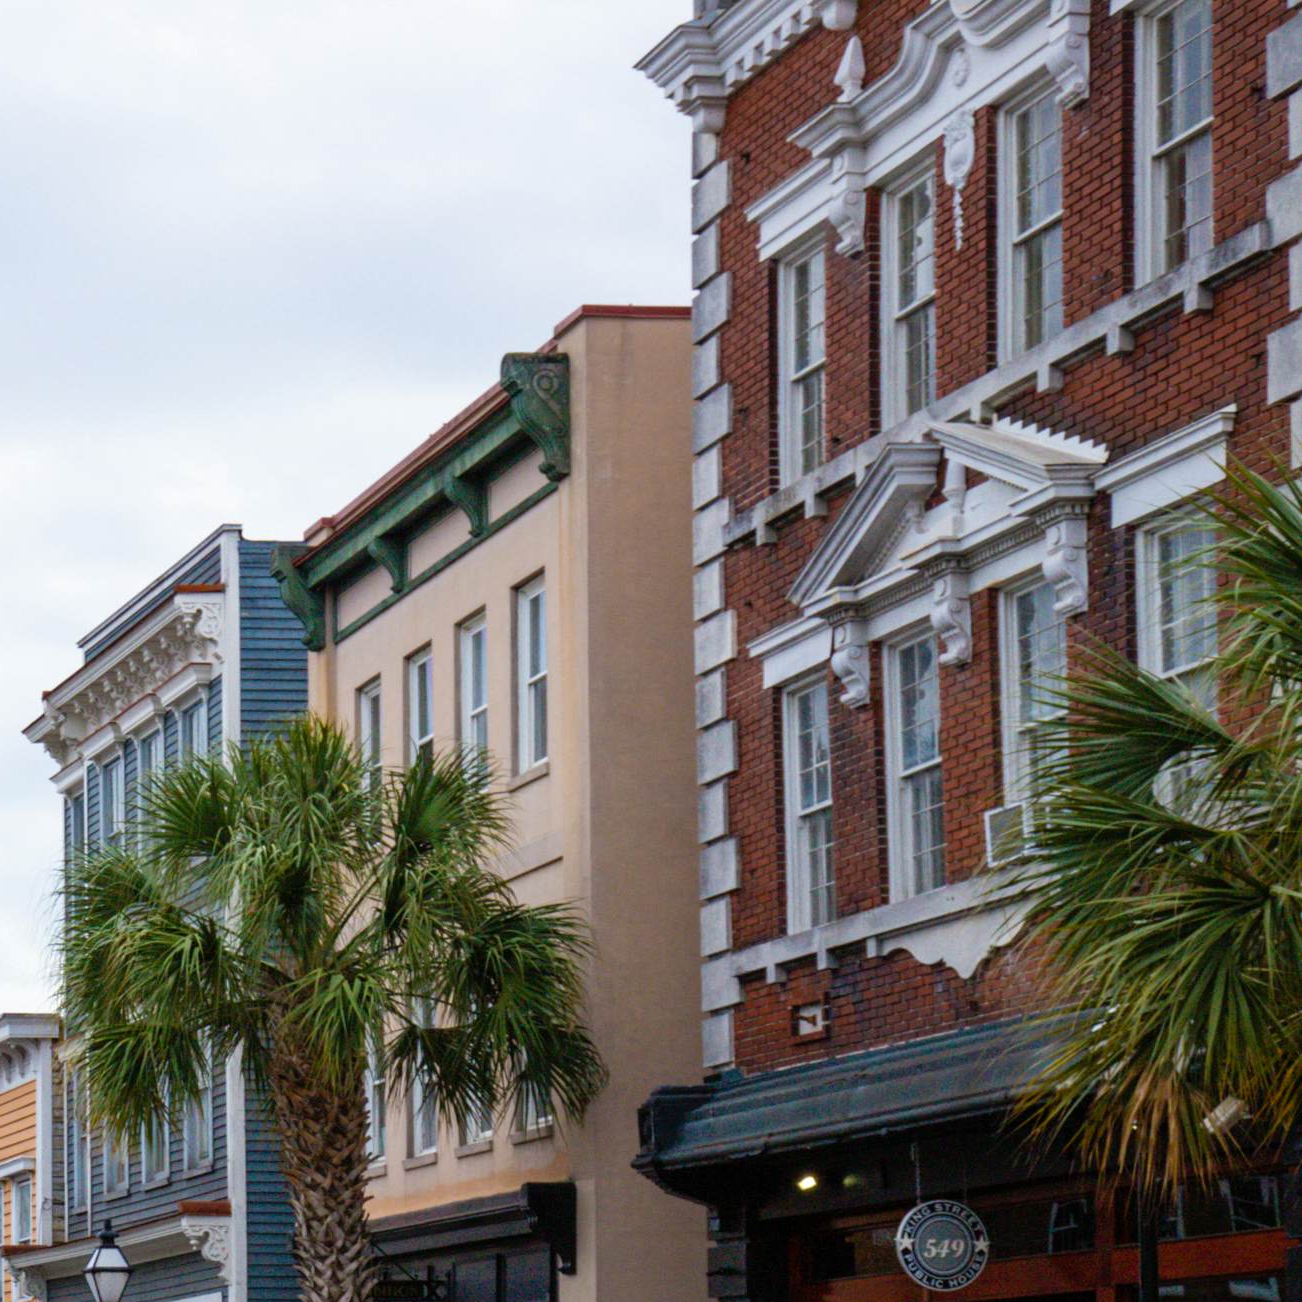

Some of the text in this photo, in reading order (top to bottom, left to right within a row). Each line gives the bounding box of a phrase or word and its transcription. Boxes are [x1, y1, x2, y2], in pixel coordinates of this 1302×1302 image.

[904, 1203, 981, 1236] KING STREET
[923, 1239, 965, 1258] 549
[904, 1253, 984, 1288] PUBLIC HOUSE
